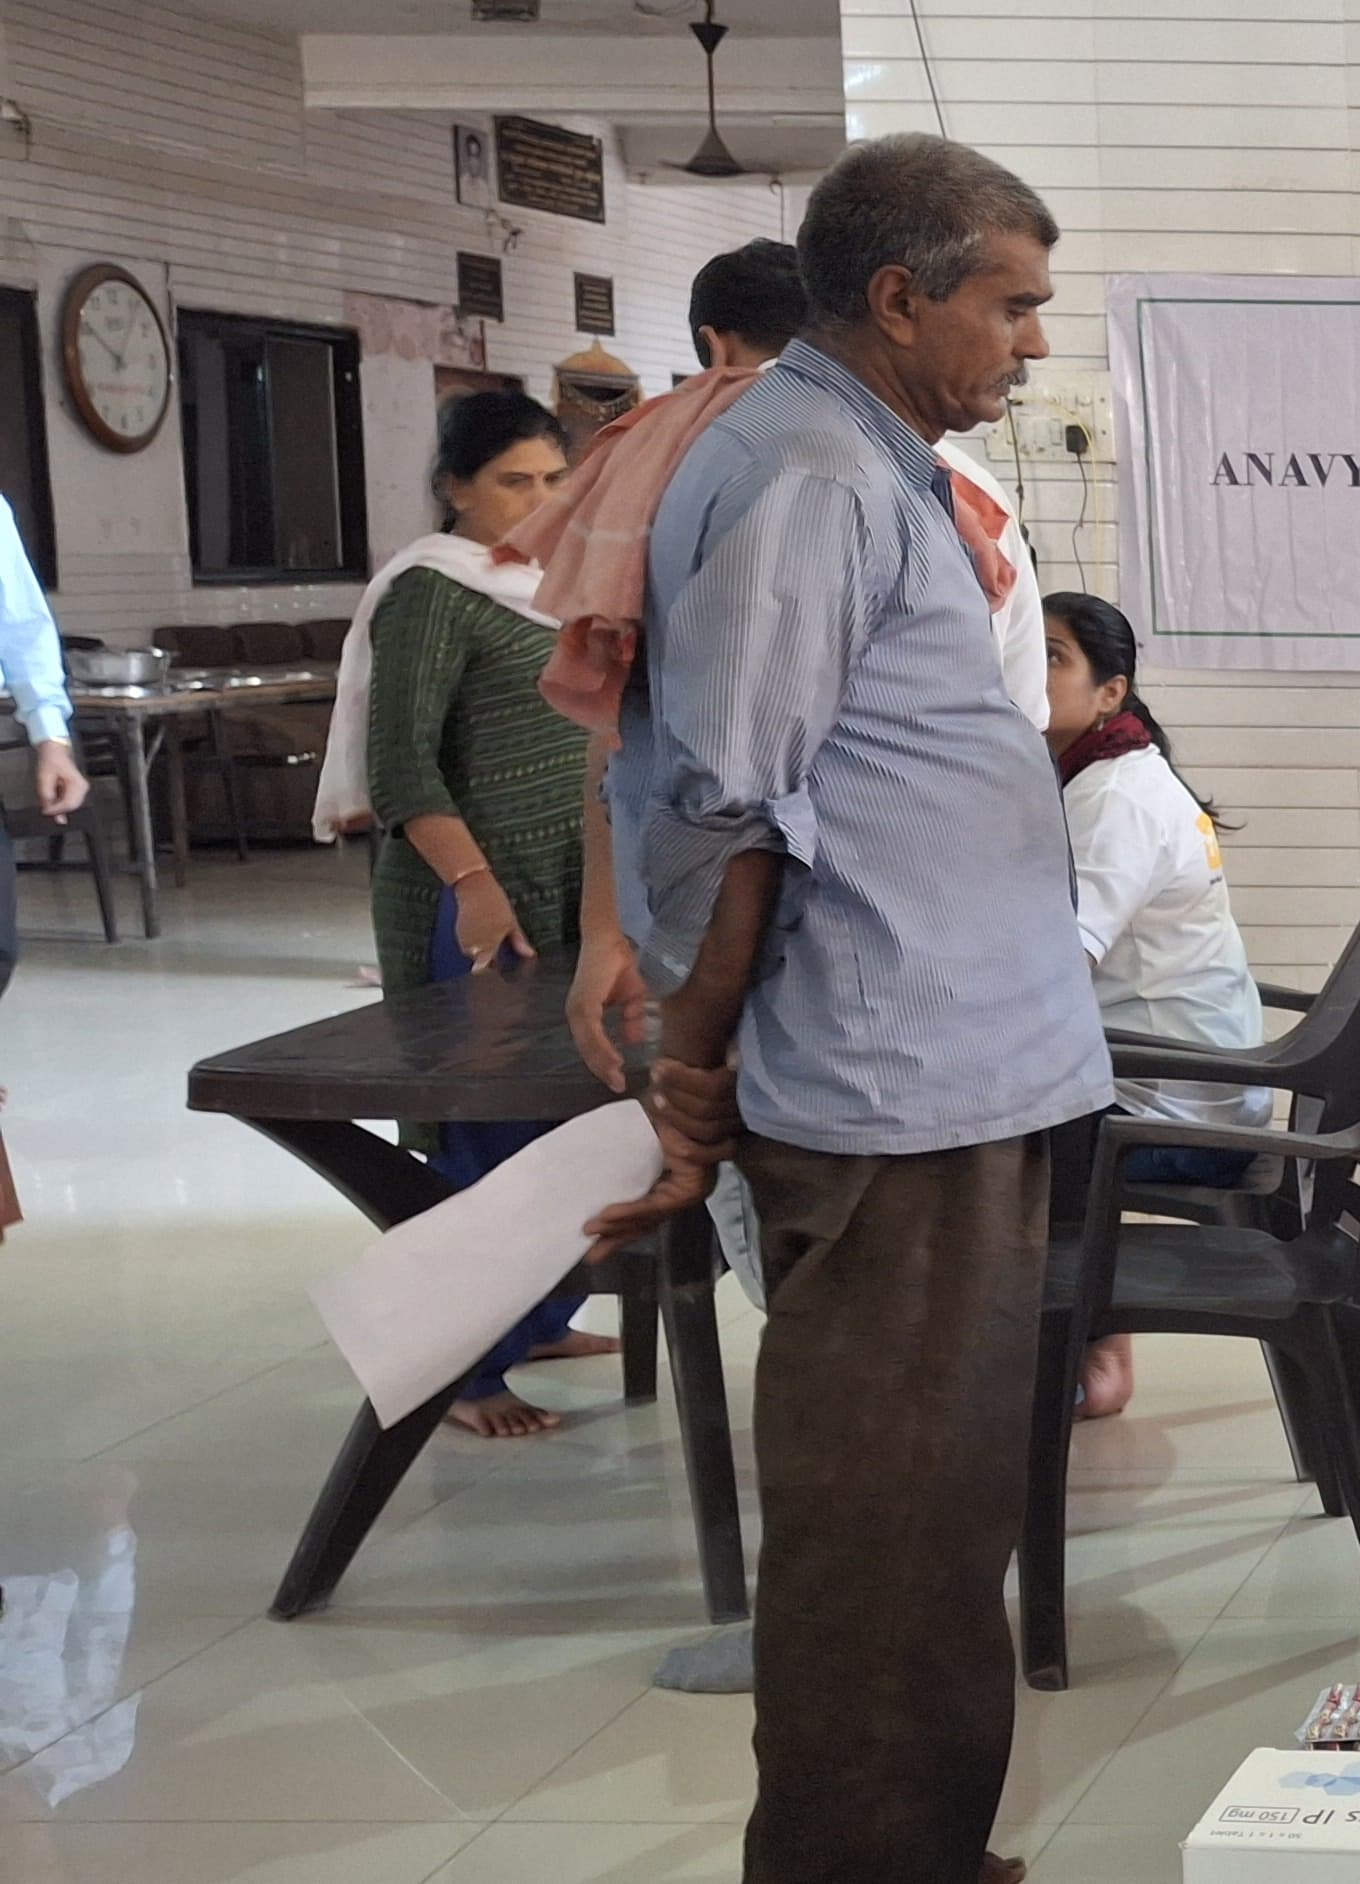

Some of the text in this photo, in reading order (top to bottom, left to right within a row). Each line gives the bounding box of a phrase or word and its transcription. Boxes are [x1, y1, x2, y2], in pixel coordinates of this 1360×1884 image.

[1227, 1807, 1255, 1819] mg
[1257, 1810, 1290, 1822] 150
[1302, 1808, 1336, 1825] IP
